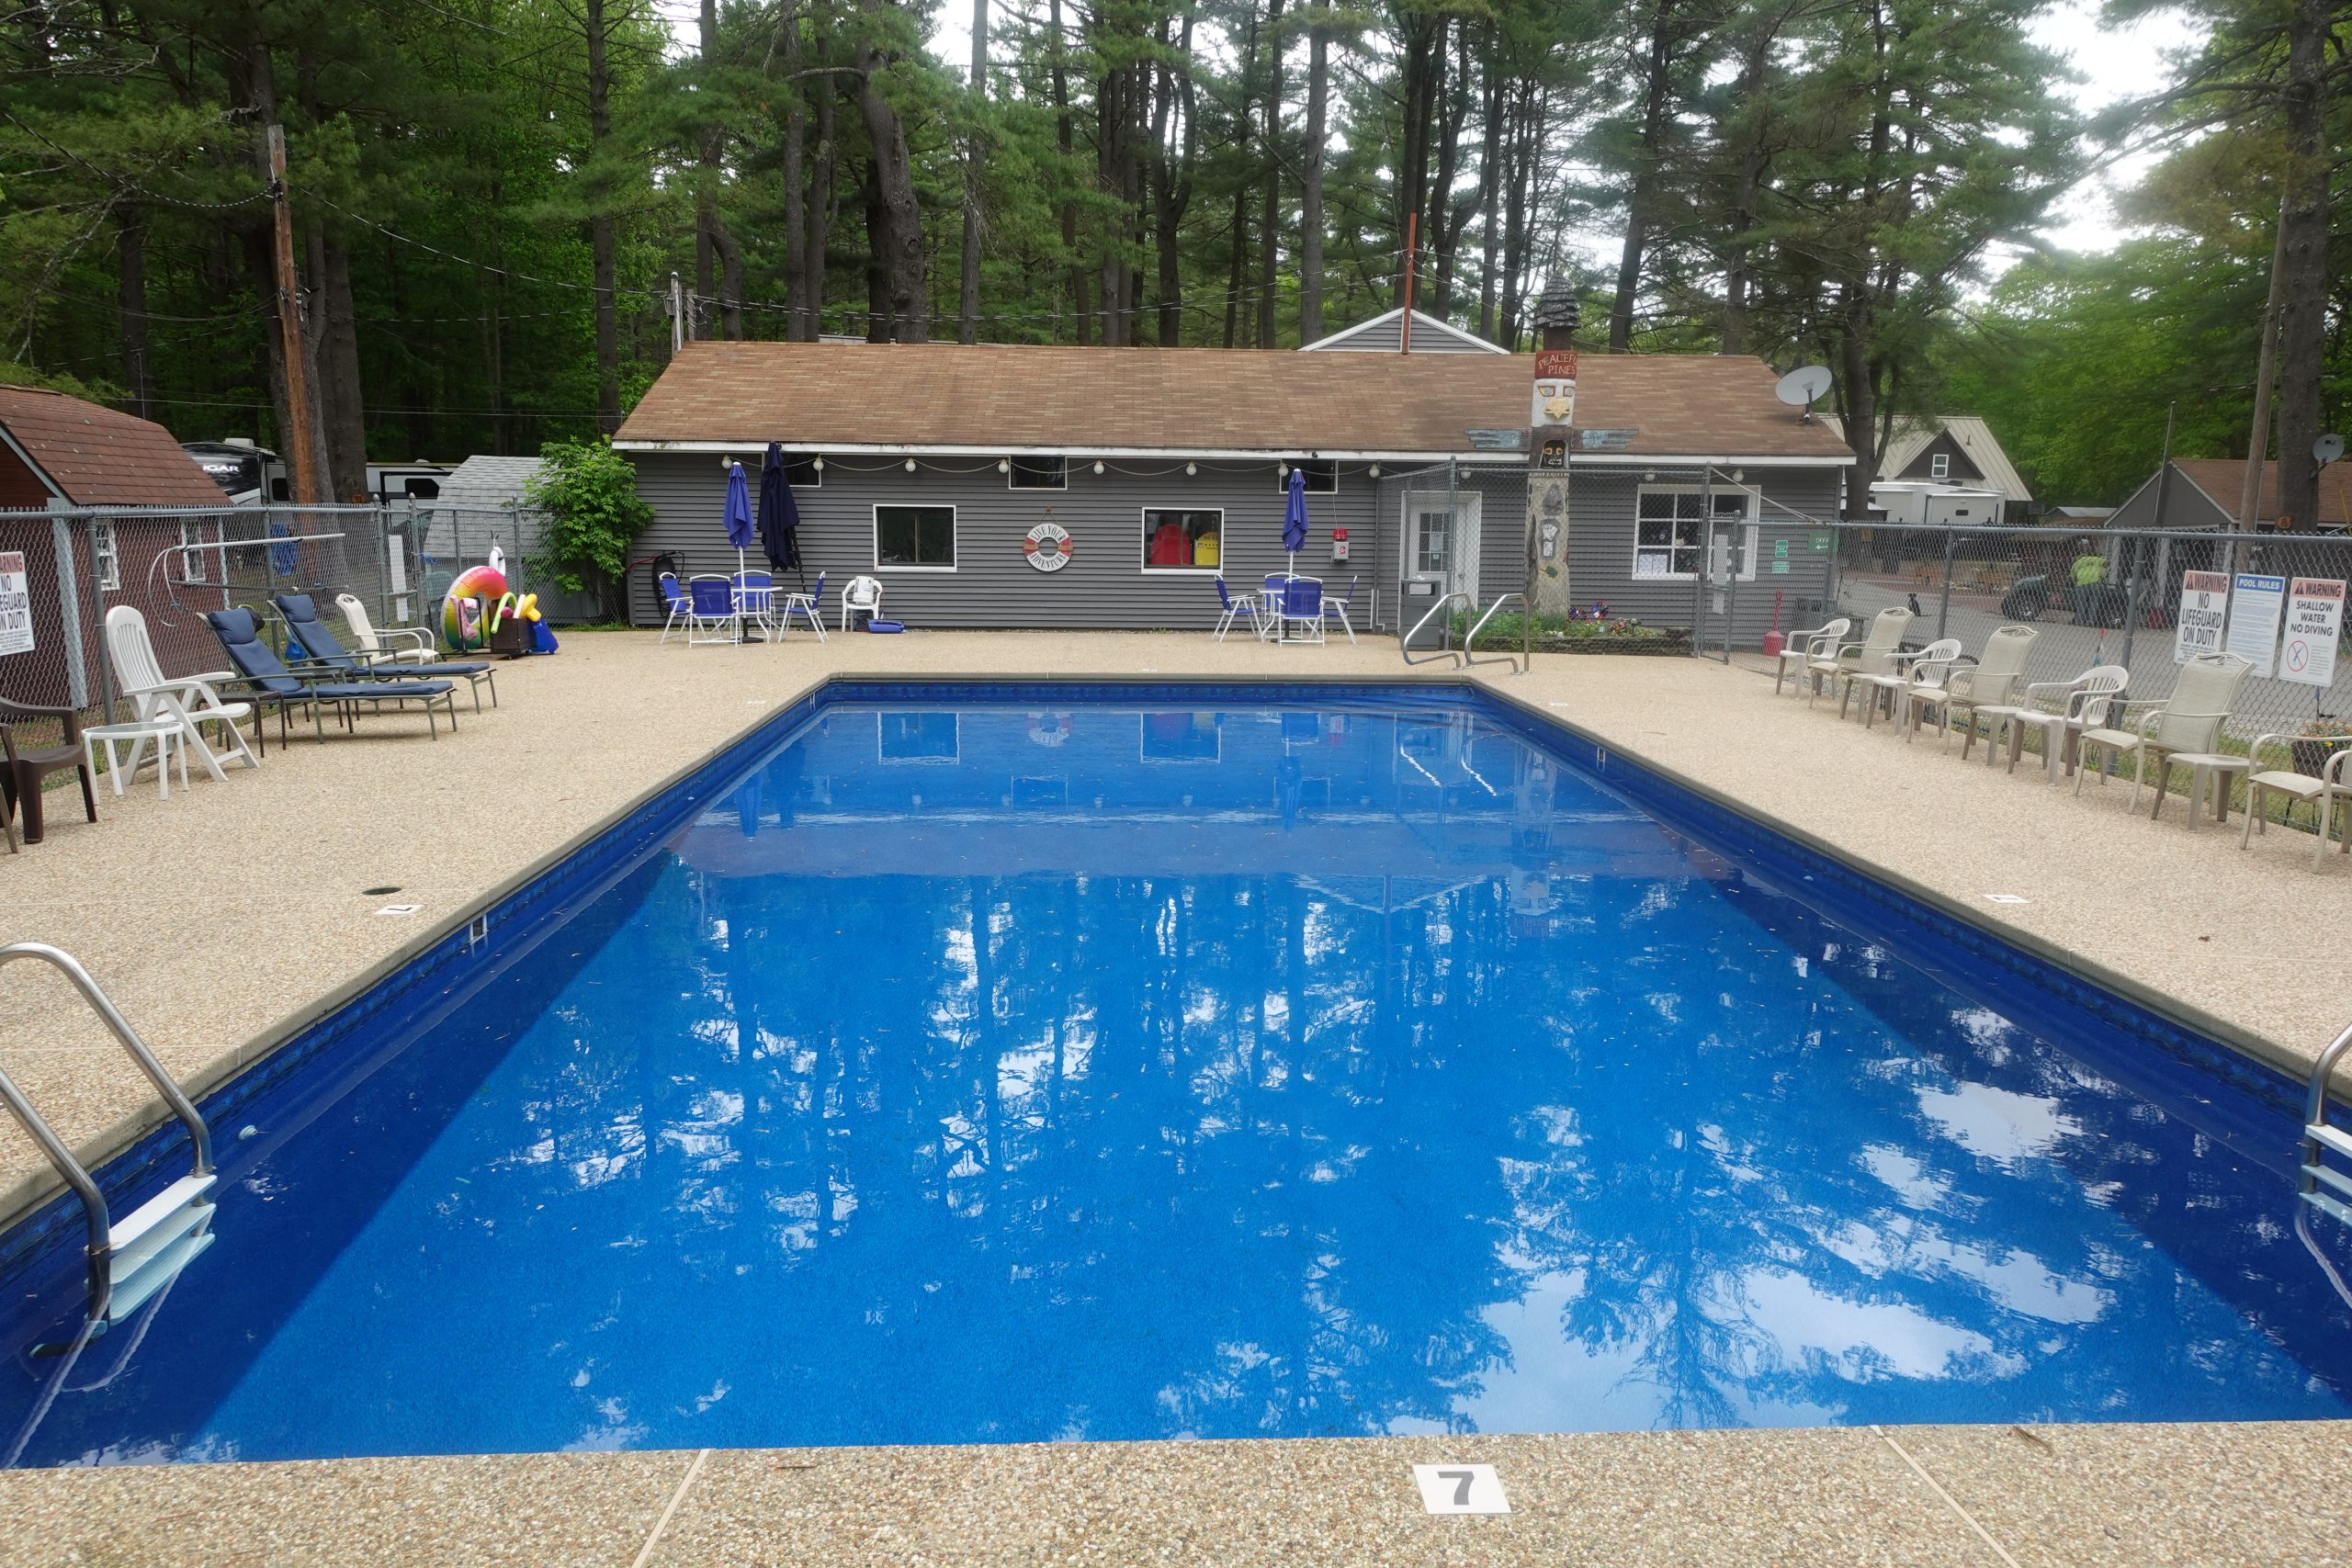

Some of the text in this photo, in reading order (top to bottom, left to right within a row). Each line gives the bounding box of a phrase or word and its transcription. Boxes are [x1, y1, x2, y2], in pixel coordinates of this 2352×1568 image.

[1548, 365, 1576, 375] PINES
[1031, 525, 1066, 542] LIVE YOUR
[1030, 553, 1067, 569] ADVENTURE
[0, 574, 12, 592] NO
[2195, 573, 2227, 593] WARNING
[2239, 579, 2280, 590] POOL RULES
[2306, 582, 2341, 597] WARNING
[2198, 592, 2210, 609] NO
[2296, 600, 2335, 613] SHALLOW
[8, 611, 26, 630] DUTY
[2181, 608, 2222, 629] LIFEGUARD
[2301, 613, 2326, 624] WATER
[2183, 626, 2217, 647] ON DUTY
[2290, 623, 2334, 637] NO DIVING
[1437, 1471, 1476, 1506] 7
